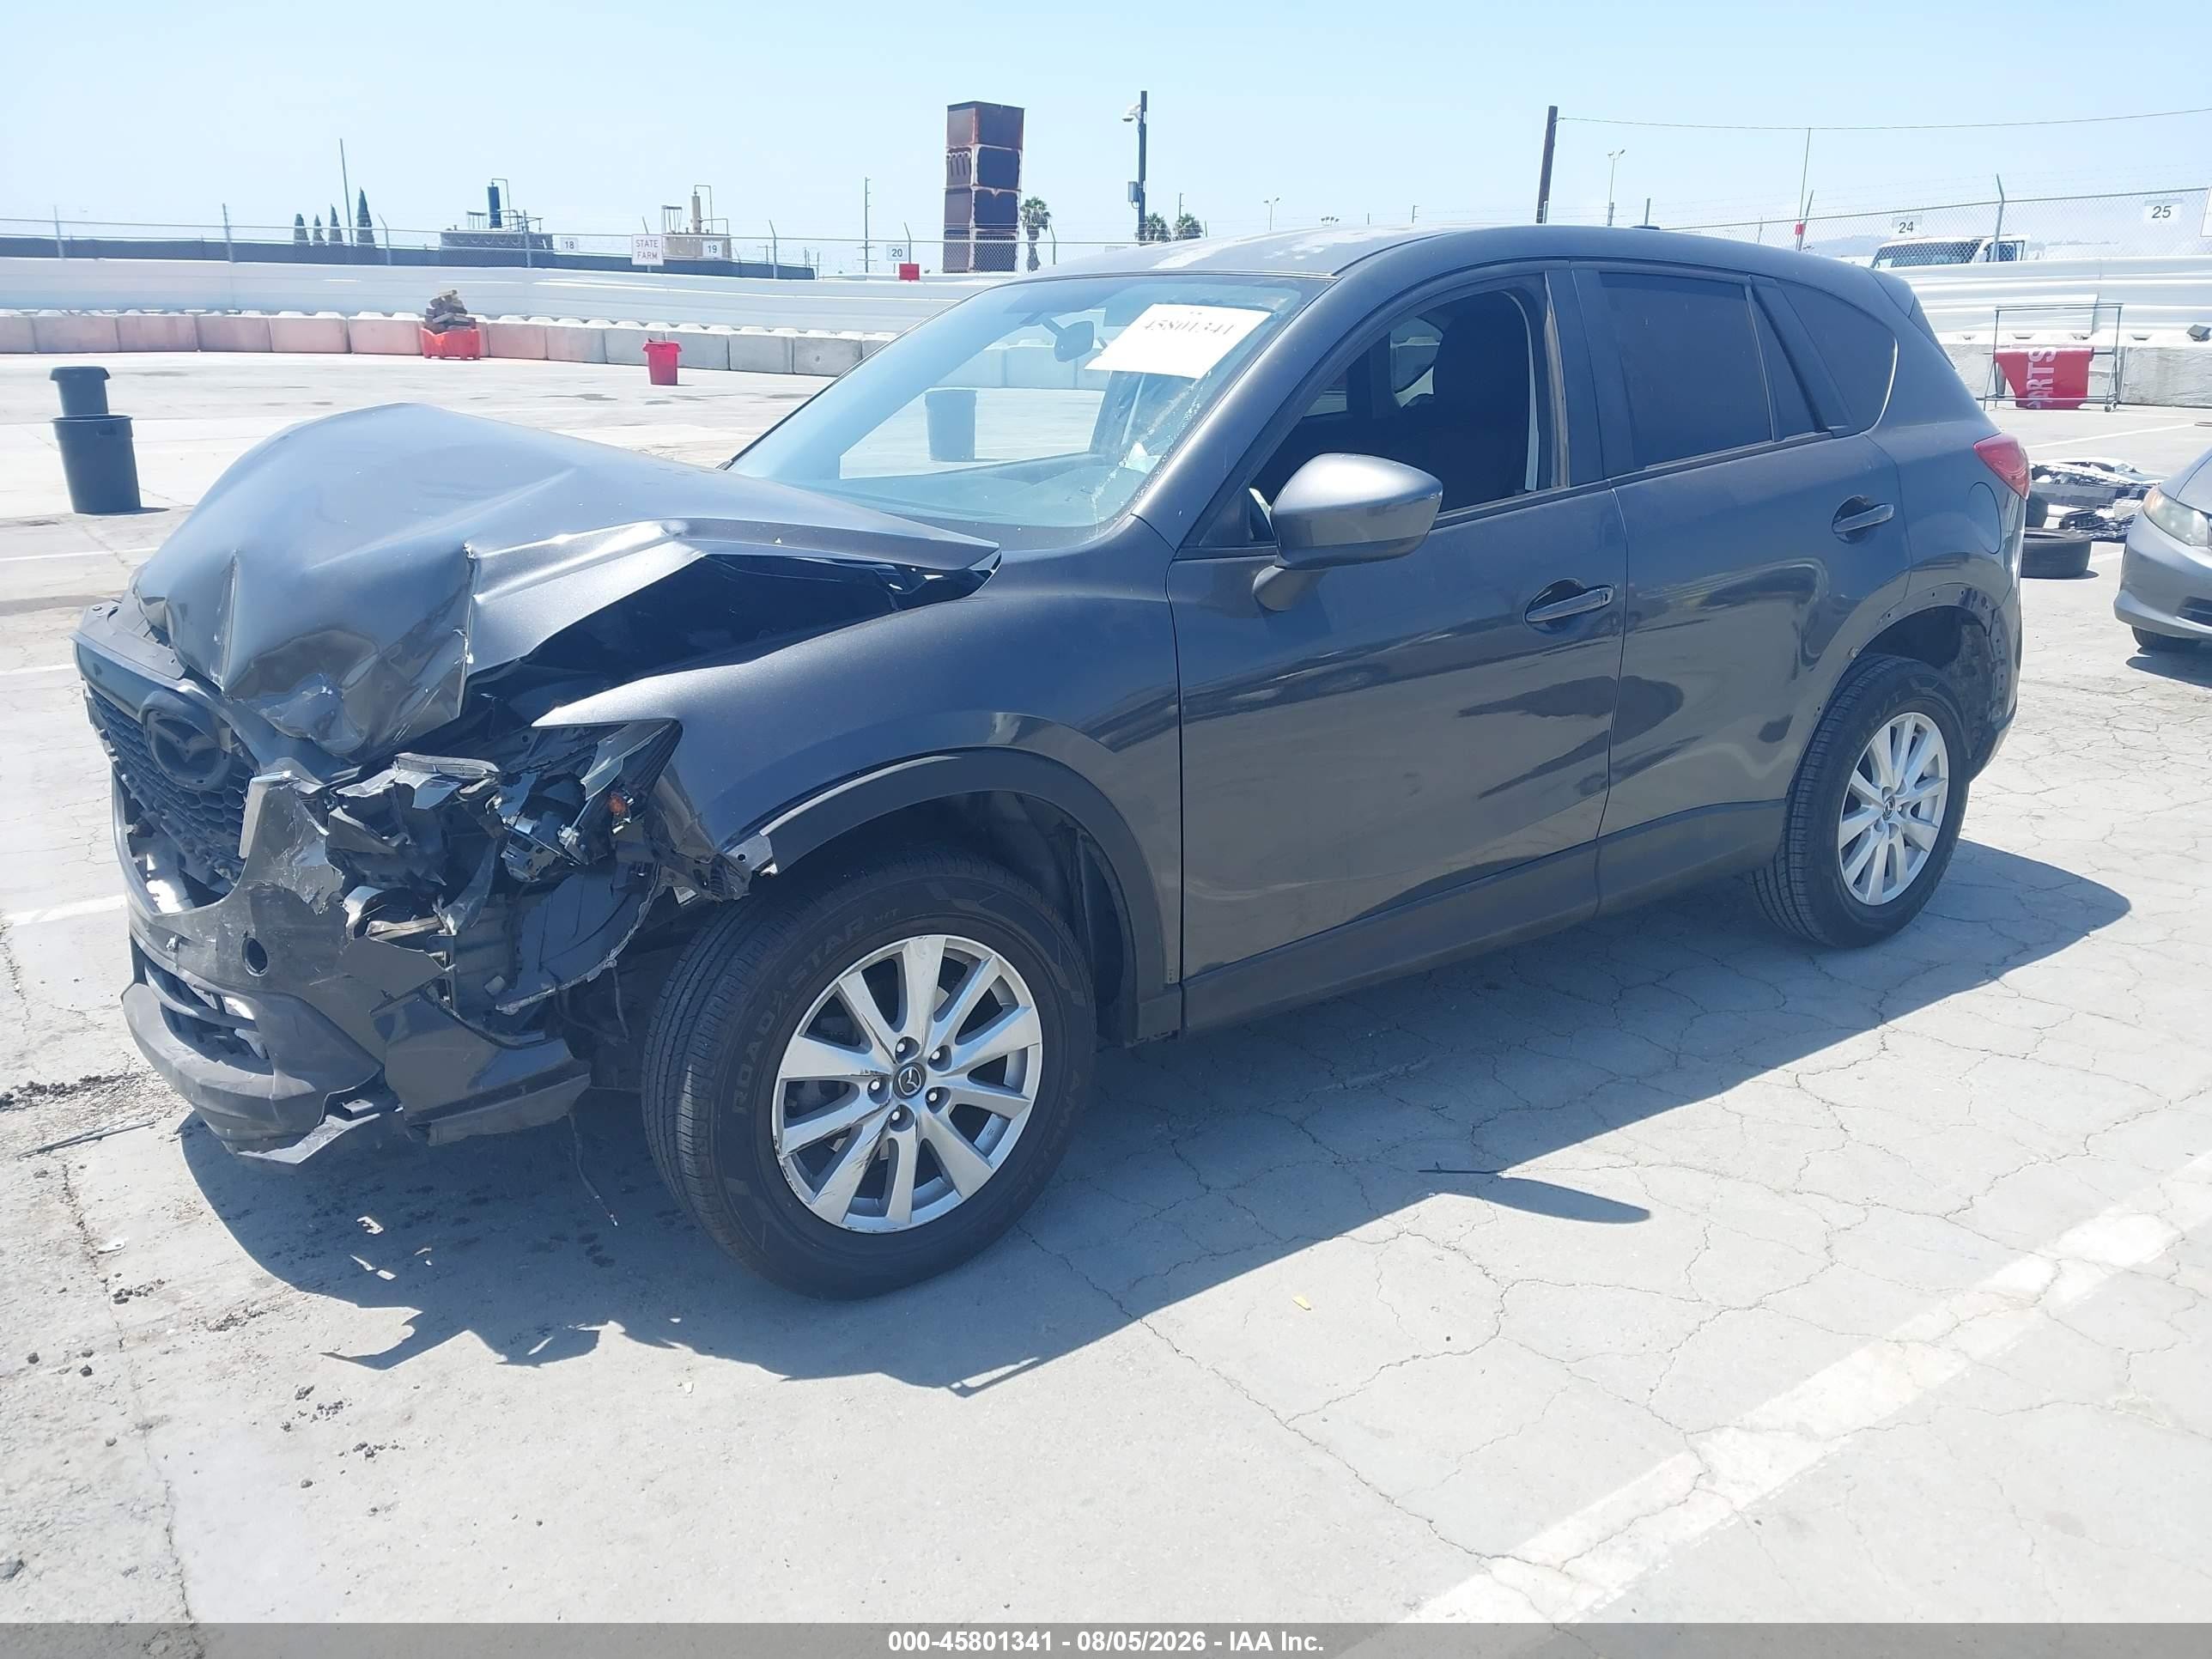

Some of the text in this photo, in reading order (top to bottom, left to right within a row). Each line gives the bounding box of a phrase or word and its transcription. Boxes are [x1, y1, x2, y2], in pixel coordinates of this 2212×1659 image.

[2151, 205, 2173, 220] 25
[1898, 221, 1915, 234] 24
[564, 240, 574, 249] 18
[635, 240, 659, 248] STATE
[707, 245, 718, 253] 19
[891, 248, 903, 258] 20
[636, 252, 658, 260] FARM
